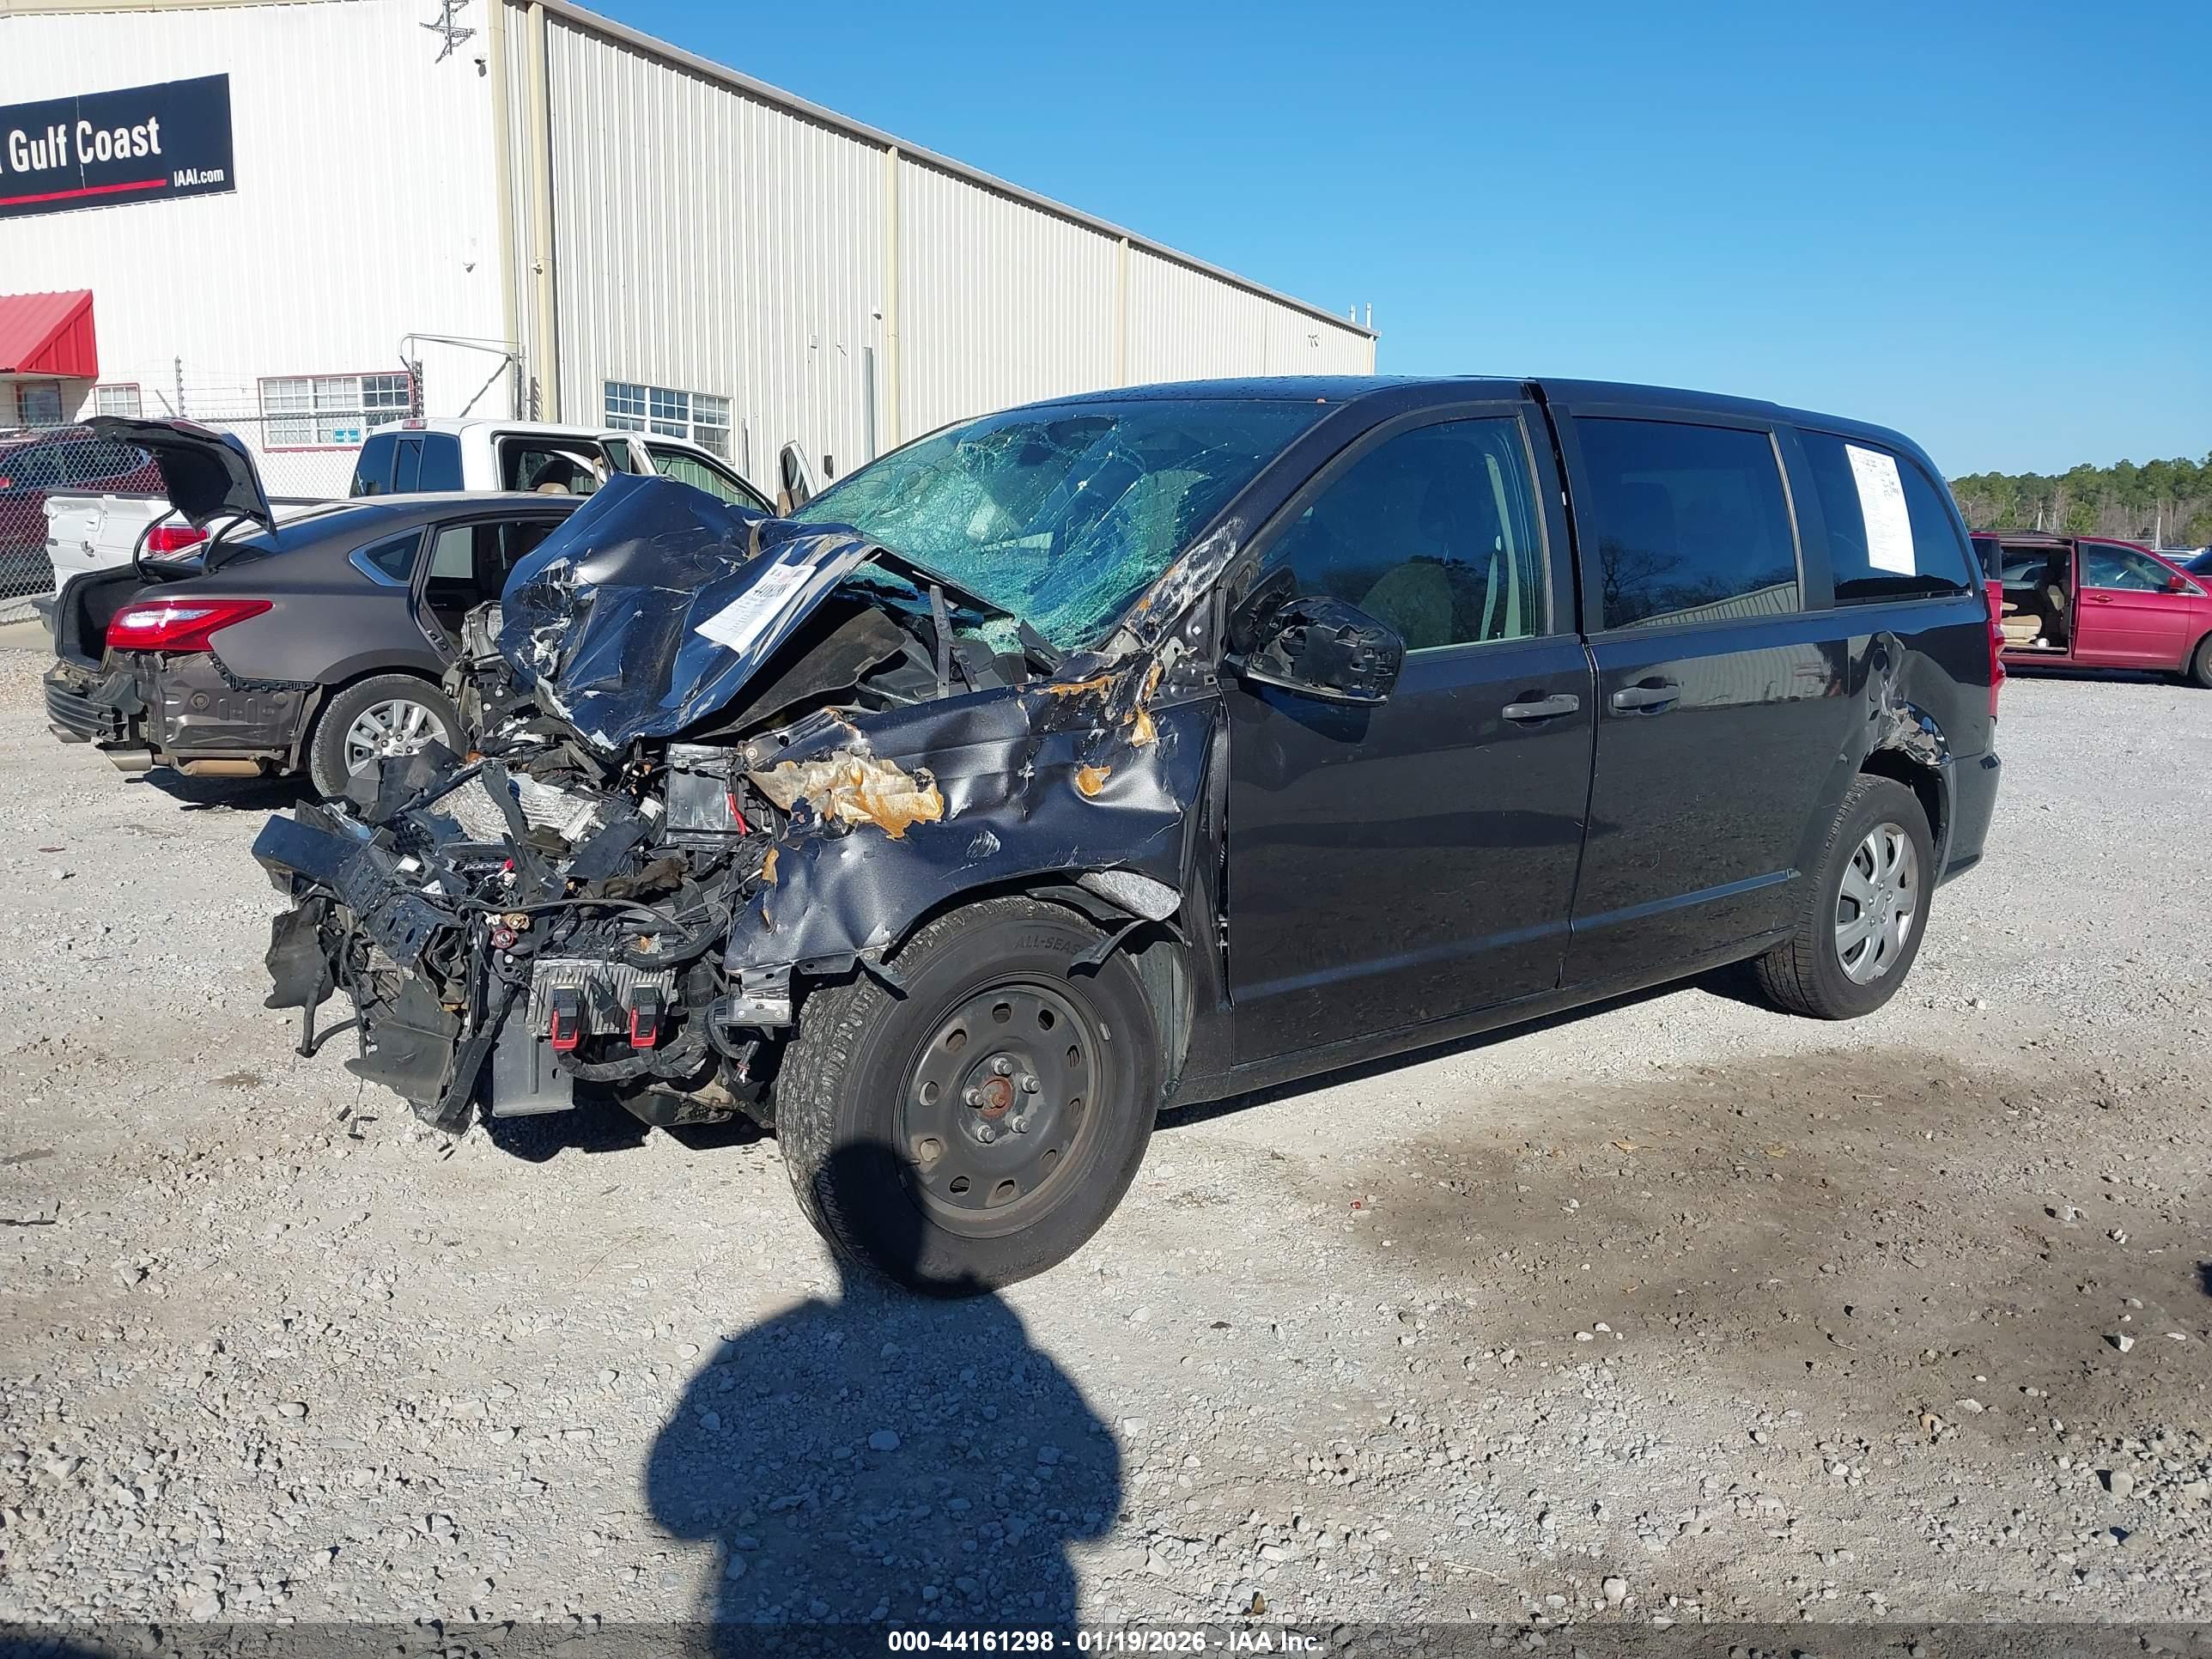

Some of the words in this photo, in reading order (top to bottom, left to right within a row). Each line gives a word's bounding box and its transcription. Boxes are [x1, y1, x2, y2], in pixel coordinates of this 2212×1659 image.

[9, 124, 68, 173] Gulf
[76, 116, 162, 164] Coast
[173, 167, 225, 187] IAAI.com
[1012, 933, 1081, 956] ALL-SEAS
